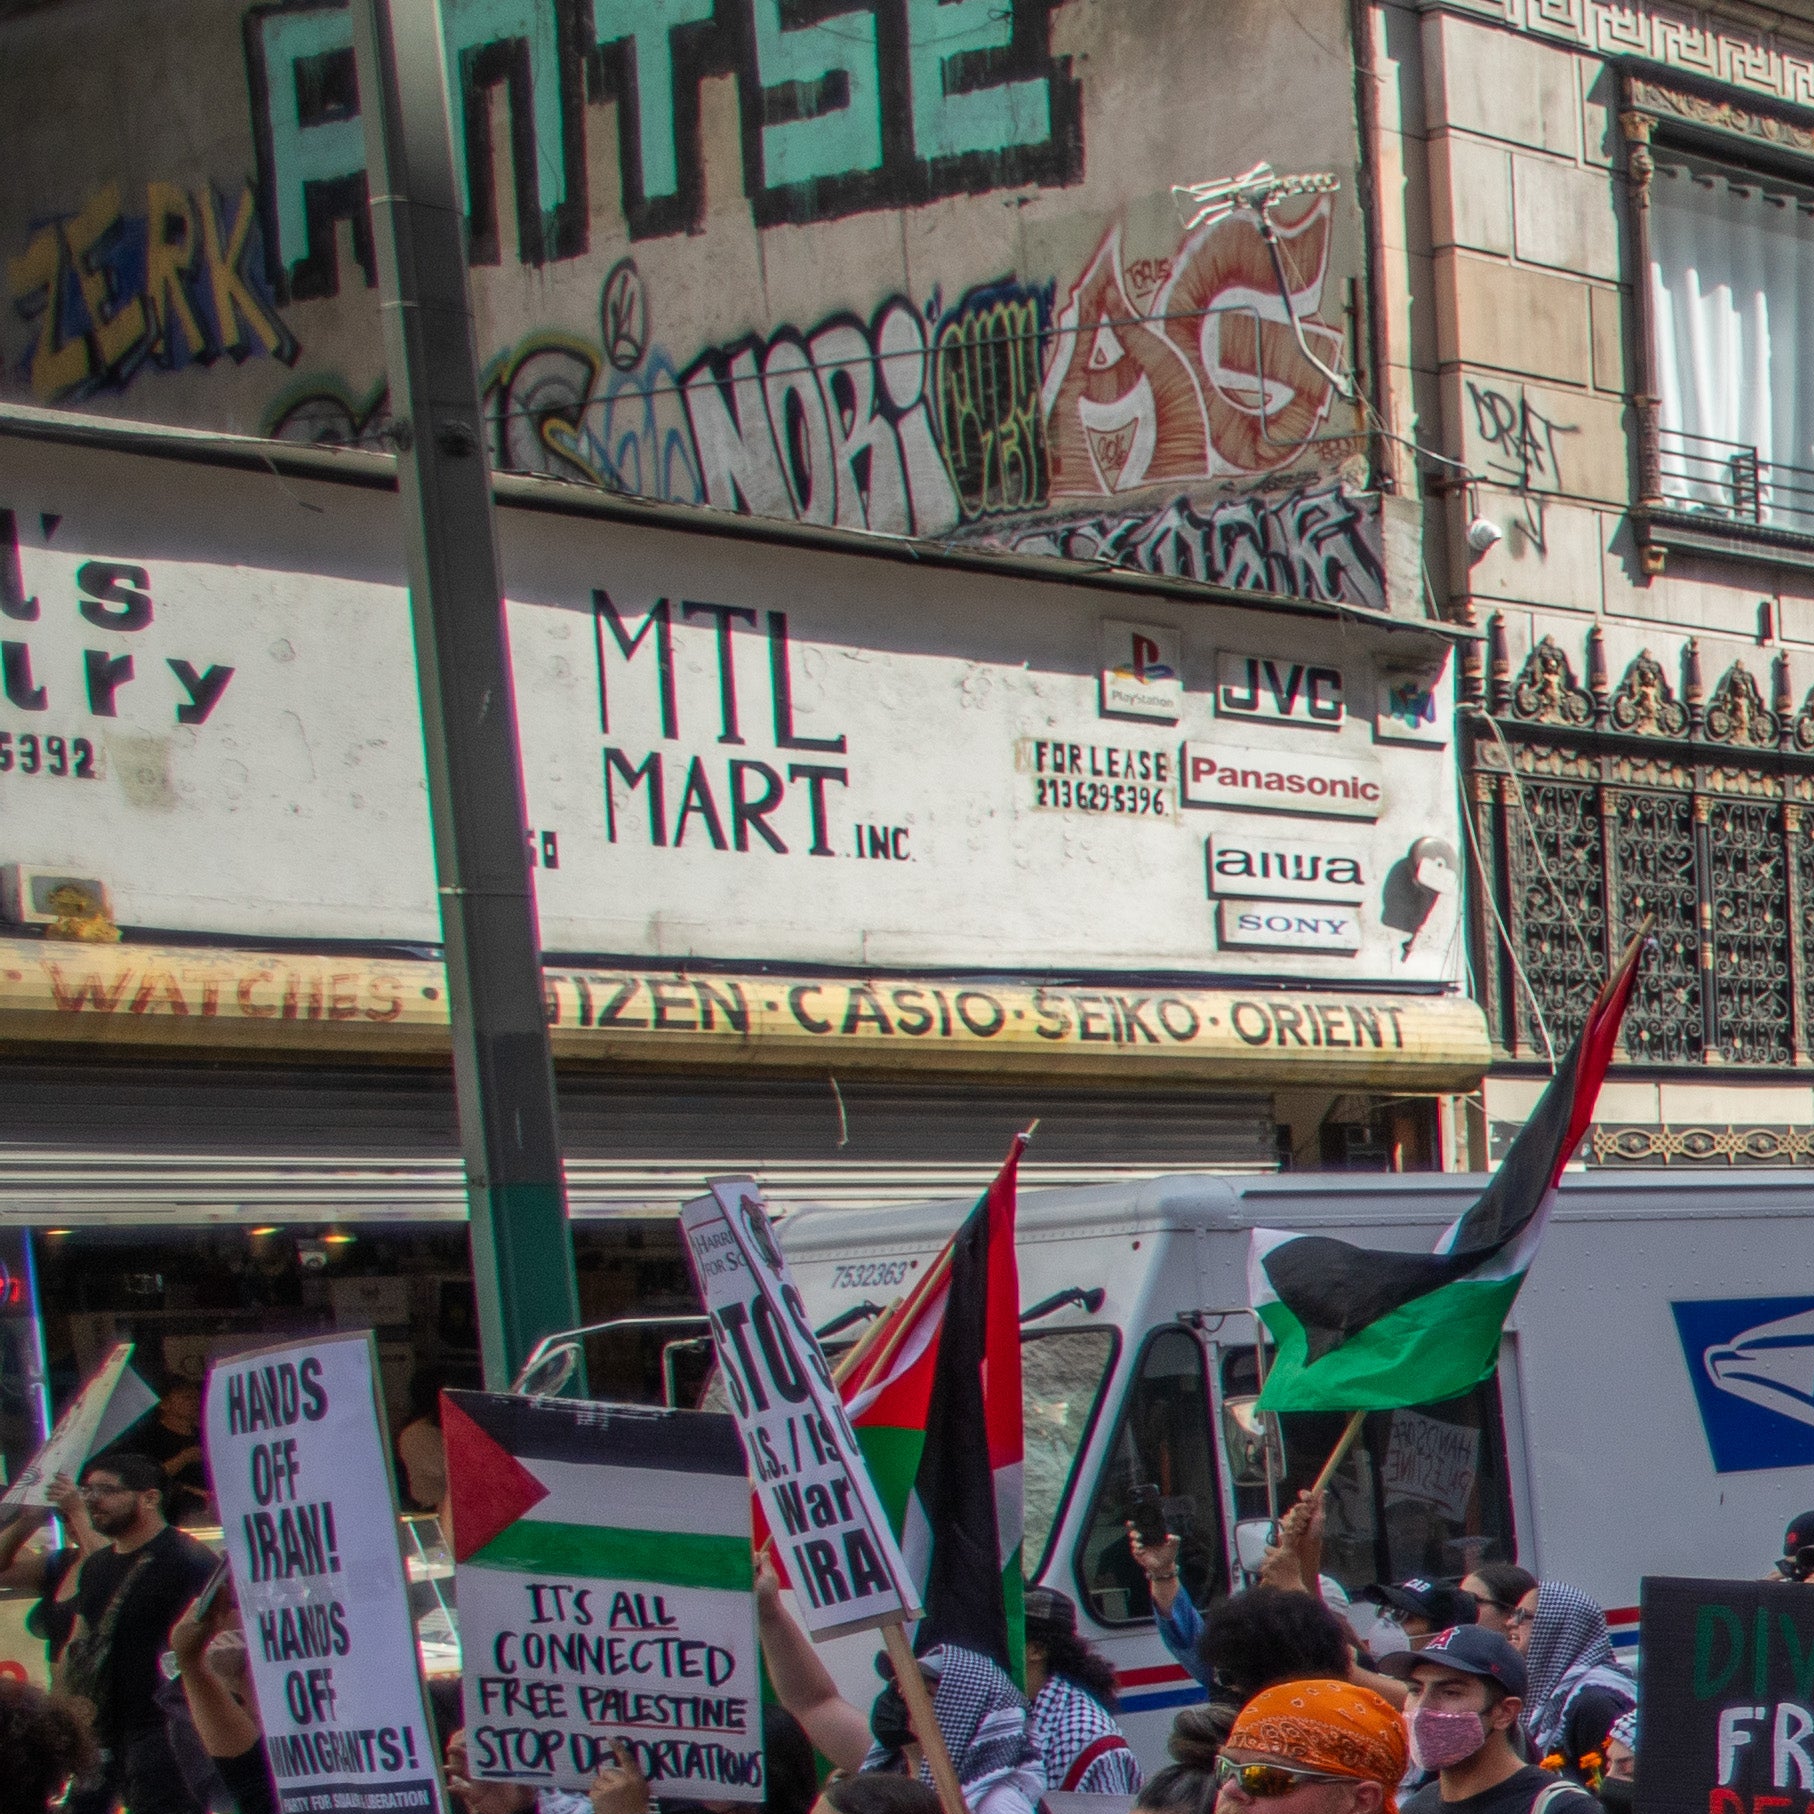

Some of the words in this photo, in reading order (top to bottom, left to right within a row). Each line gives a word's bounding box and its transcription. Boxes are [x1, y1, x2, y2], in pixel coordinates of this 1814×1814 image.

[592, 588, 846, 753] MTL
[1112, 689, 1174, 708] PlayStation
[1222, 658, 1346, 721] JVC
[1035, 741, 1082, 774] FOR
[1090, 746, 1167, 782] LEASE
[1191, 756, 1380, 801] Panasonic
[603, 747, 848, 857] MART
[1215, 847, 1364, 885] aiwa
[1238, 913, 1348, 936] SONY
[42, 958, 405, 1025] WATCHES
[788, 983, 1006, 1038] CASIO
[1036, 985, 1199, 1046] SEIKO
[1231, 999, 1406, 1050] ORIENT
[830, 1259, 908, 1290] 7532363
[226, 1357, 329, 1437] HANDS
[249, 1438, 301, 1507] OFF
[772, 1475, 856, 1536] War
[243, 1501, 342, 1584] IRAN!
[257, 1601, 352, 1663] HANDS
[525, 1584, 593, 1625] IT'S
[609, 1592, 678, 1628] ALL
[493, 1630, 736, 1687] CONNECTED
[285, 1667, 337, 1726] OFF
[478, 1677, 568, 1719] FREE
[579, 1686, 747, 1729] PALESTINE
[475, 1727, 564, 1771] STOP
